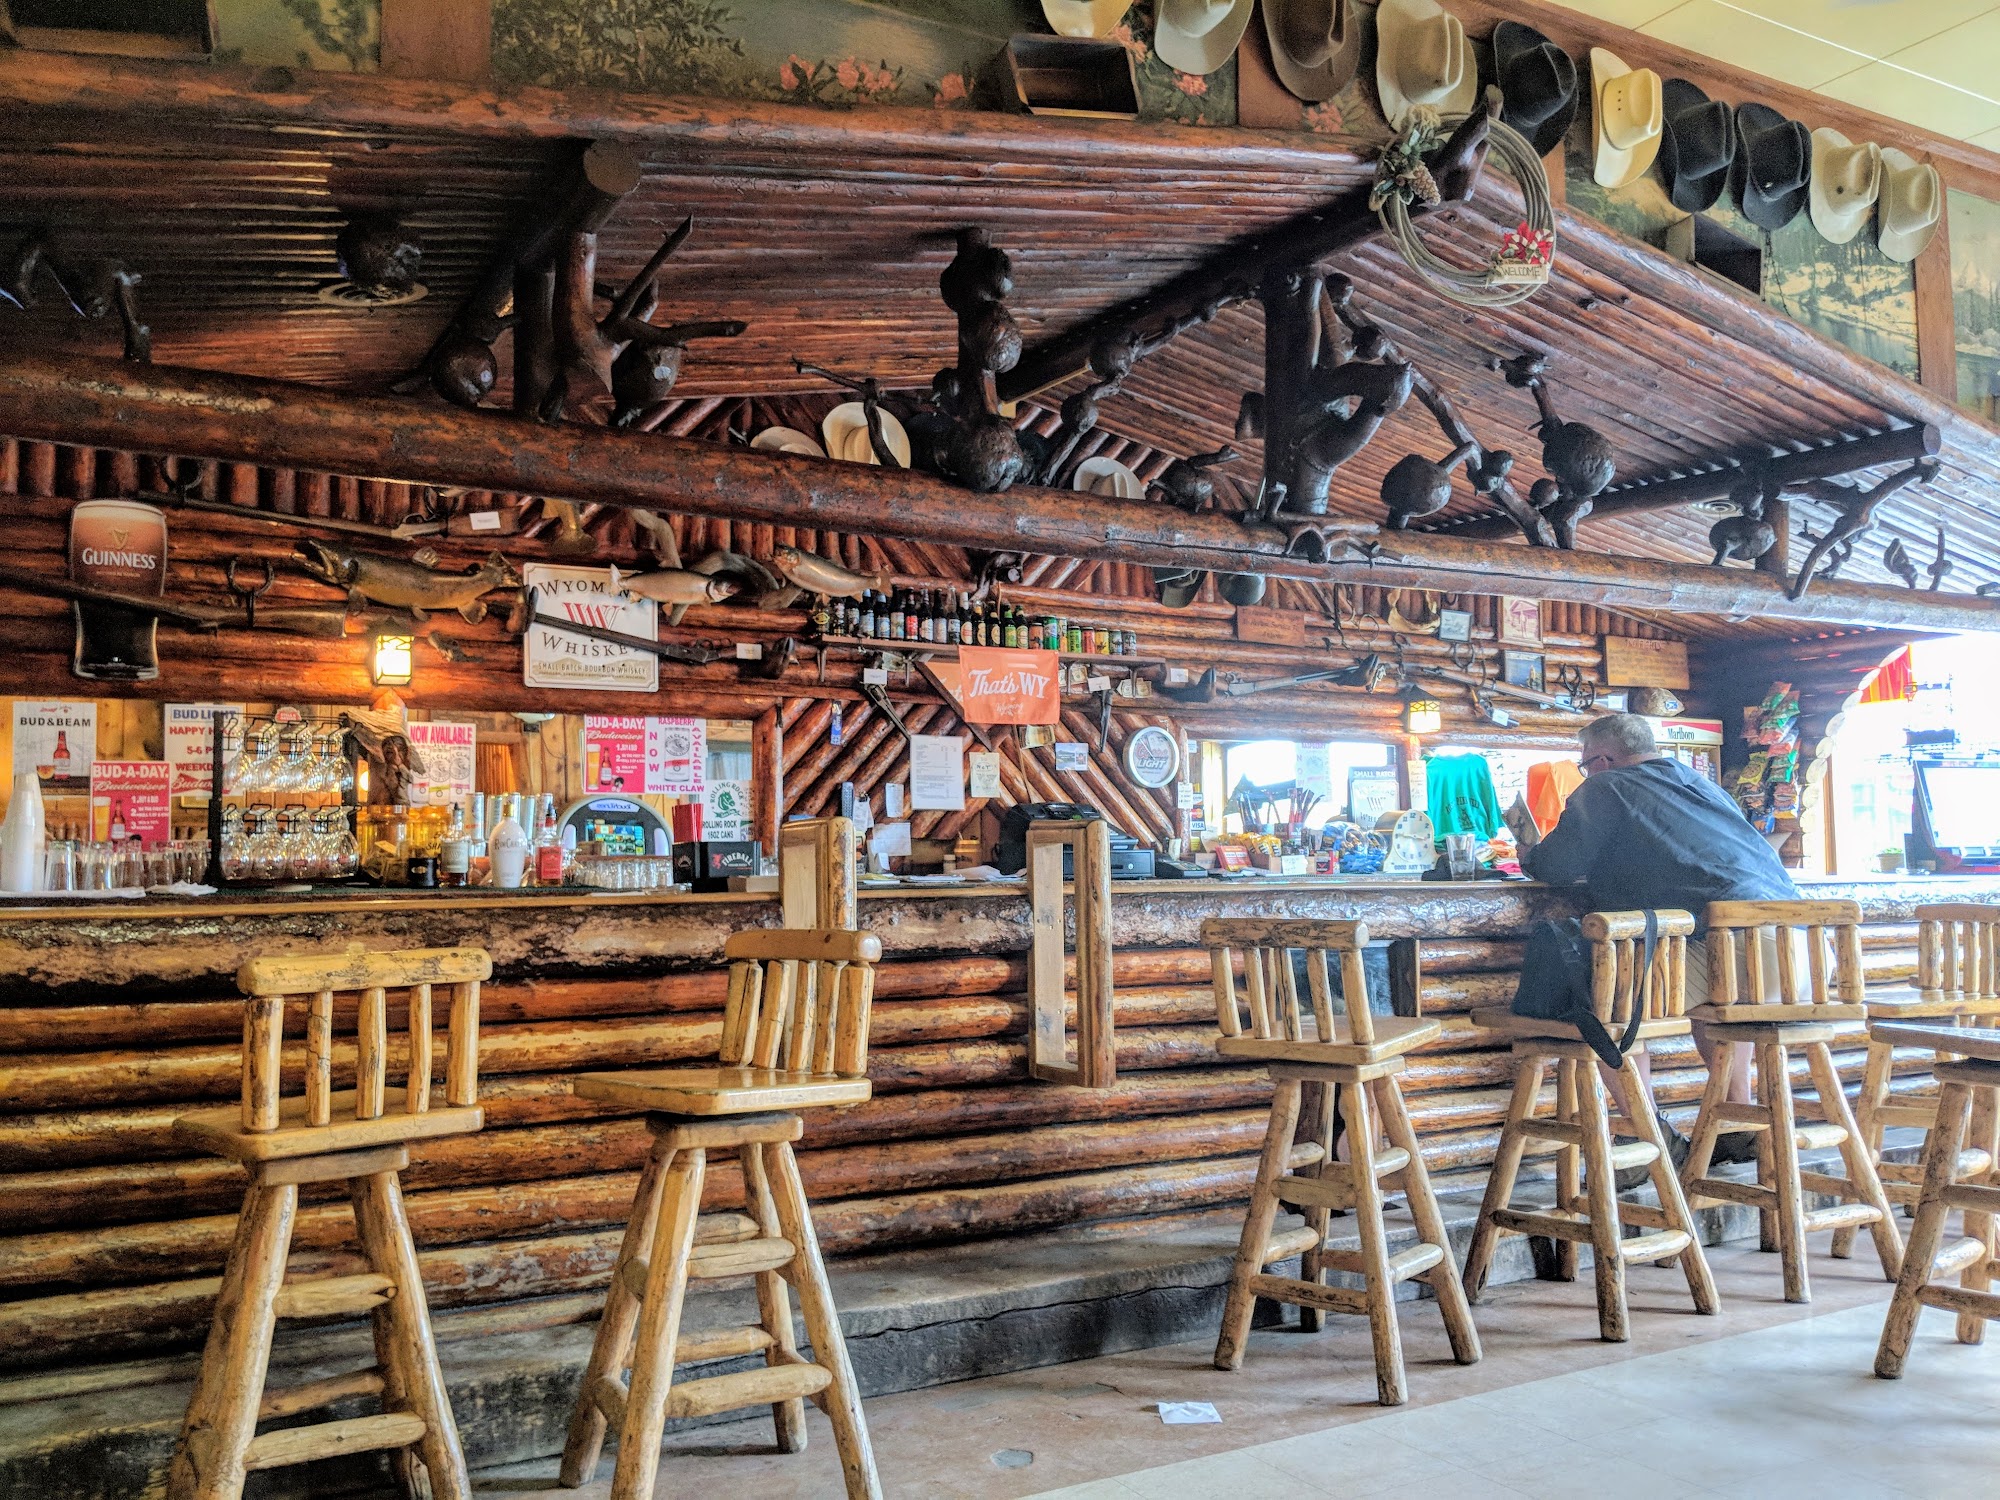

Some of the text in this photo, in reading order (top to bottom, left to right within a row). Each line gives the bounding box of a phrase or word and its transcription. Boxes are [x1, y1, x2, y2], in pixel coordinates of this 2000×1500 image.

[1500, 266, 1540, 276] WELCOME
[82, 547, 156, 569] GUINNESS
[538, 579, 630, 599] WYOMN
[541, 631, 640, 656] WHISKE
[538, 662, 559, 670] SMALL
[561, 664, 582, 672] BATCH
[584, 665, 616, 673] BOURBON
[968, 668, 1019, 698] That's
[1017, 671, 1050, 699] WY
[173, 709, 198, 719] BUD
[586, 716, 645, 730] BUD-A-DAY.
[658, 717, 696, 726] RASPBERRY
[169, 726, 205, 736] HAPPY
[410, 726, 473, 745] NOW AVAILABLE
[586, 730, 643, 740] Budweiser
[1667, 727, 1695, 740] Marlboro
[187, 746, 203, 754] 5-6
[1137, 759, 1167, 770] LIGHT
[92, 764, 169, 778] BUD-A-DAY.
[1353, 770, 1396, 778] SMALL BATCH
[93, 780, 167, 791] Budweiser
[647, 784, 705, 792] WHITE CLAW
[710, 781, 731, 803] ROLLING
[702, 820, 737, 829] ROLLING ROCK
[720, 830, 734, 838] CANS
[721, 852, 753, 866] FIREBALL
